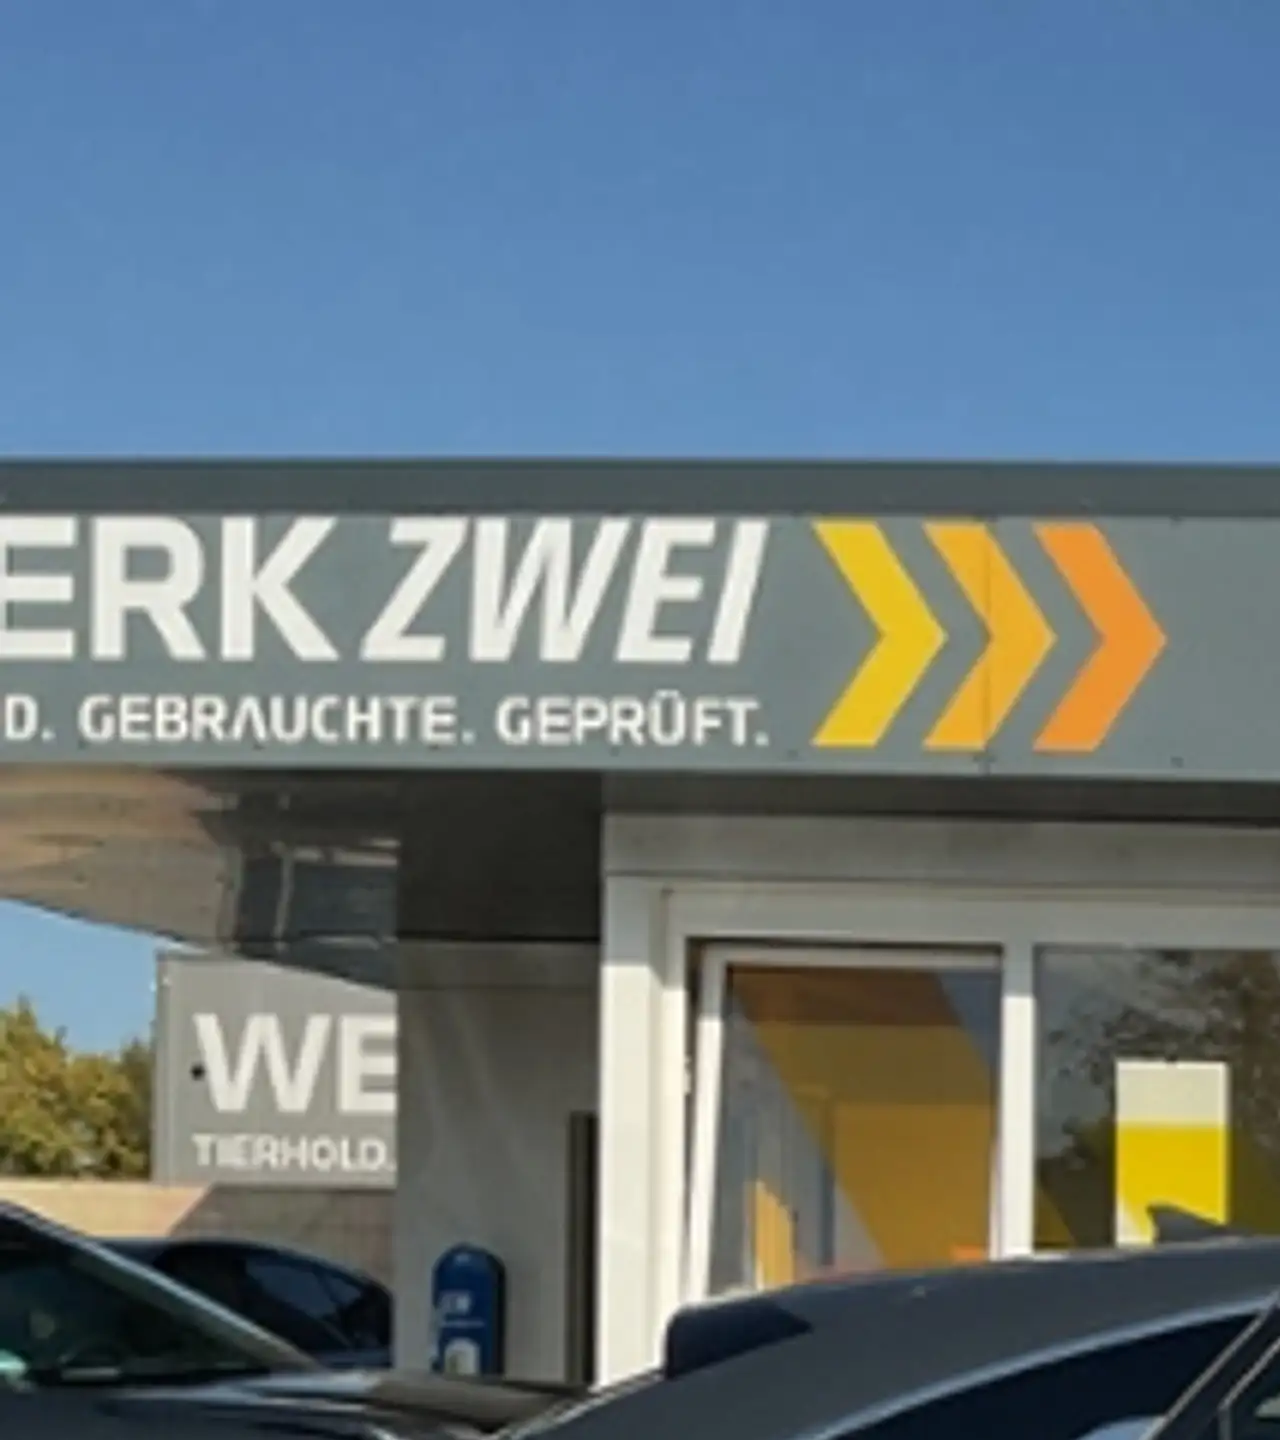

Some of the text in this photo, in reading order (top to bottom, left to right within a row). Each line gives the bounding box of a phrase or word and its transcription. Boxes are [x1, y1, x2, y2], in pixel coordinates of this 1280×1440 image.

[359, 516, 768, 665] ZWEI
[78, 694, 474, 745] GEBRAUCHTE.
[496, 690, 769, 747] GEPRÜFT.
